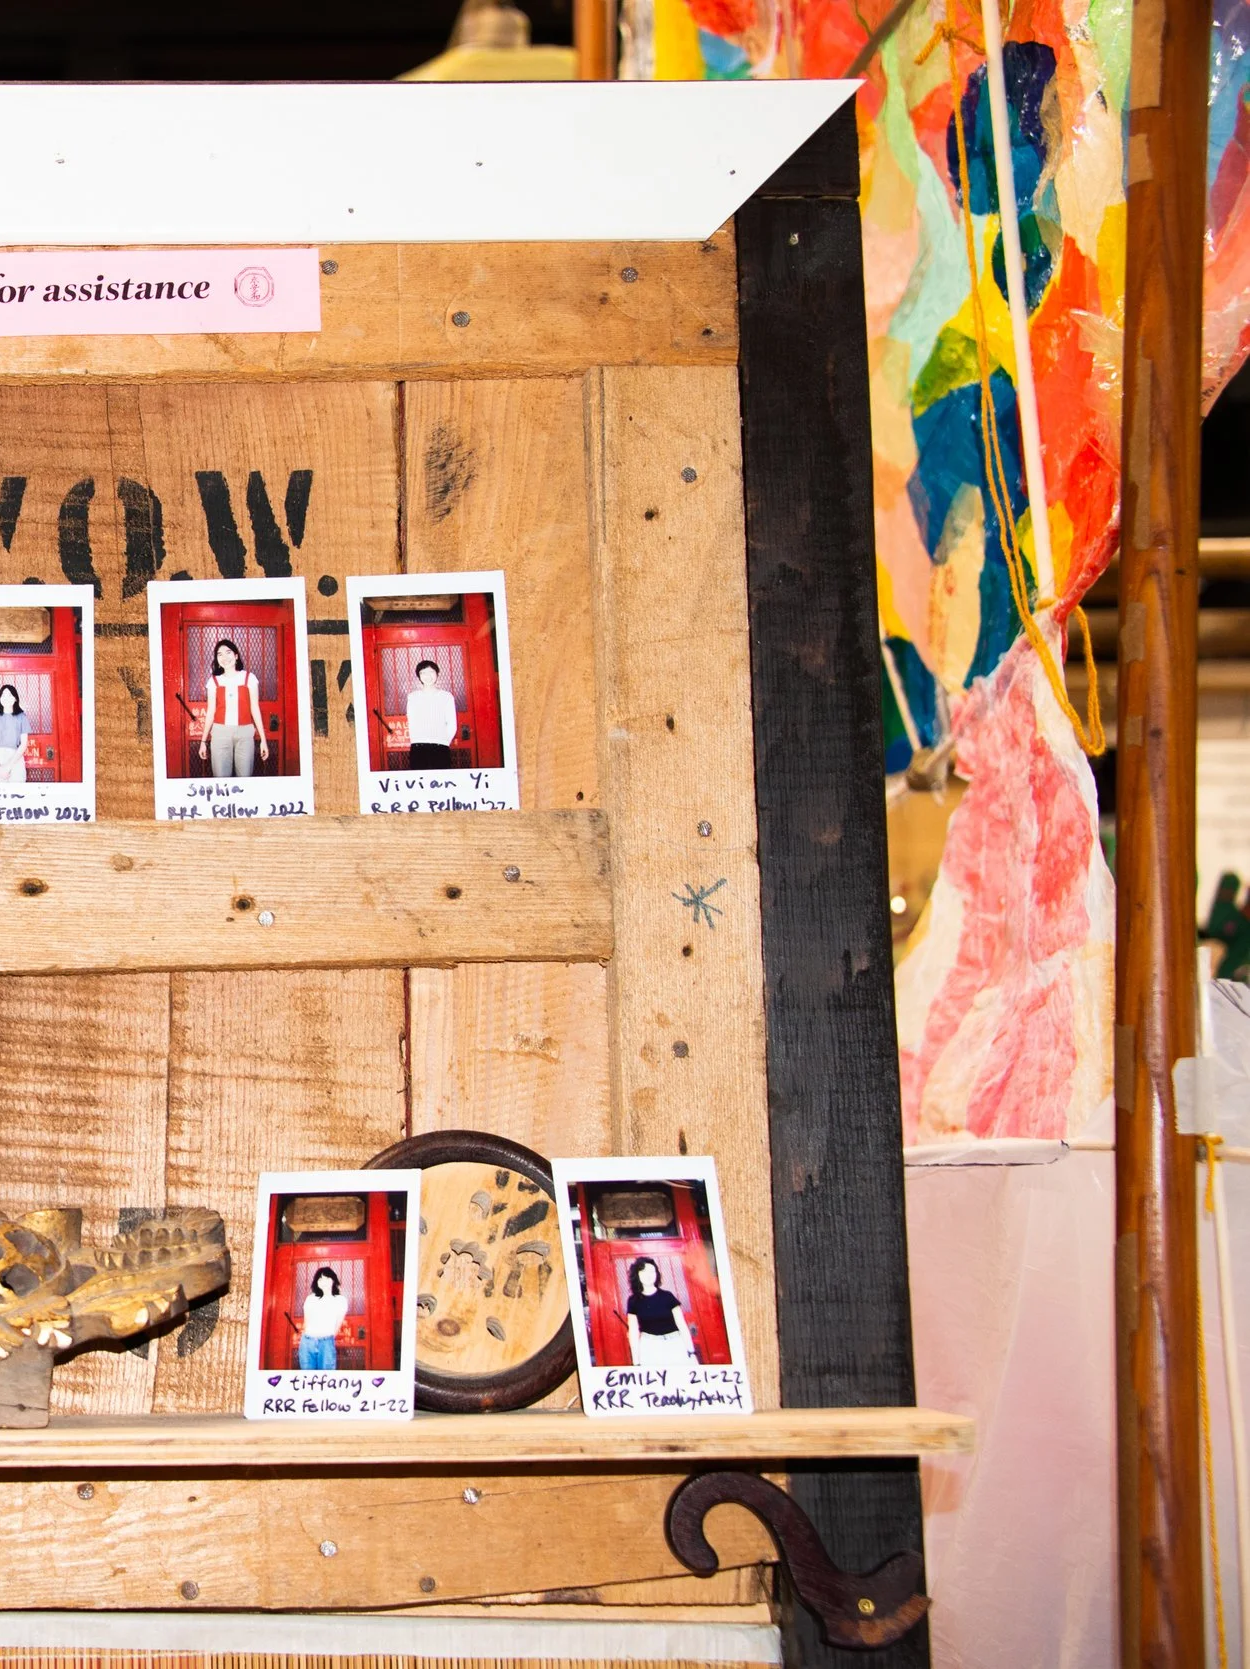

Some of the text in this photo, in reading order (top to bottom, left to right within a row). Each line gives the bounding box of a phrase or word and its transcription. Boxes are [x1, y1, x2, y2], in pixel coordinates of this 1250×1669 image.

[43, 272, 211, 302] assistance
[187, 783, 244, 801] Sophia
[379, 772, 489, 793] Vivian Yi
[167, 805, 202, 820] RRR
[268, 801, 308, 817] 2022
[371, 801, 420, 814] RRR
[290, 1374, 362, 1398] tiffany
[605, 1369, 743, 1387] EMILY 21-22
[263, 1398, 409, 1415] RRR Fellow 21-22
[592, 1389, 634, 1411] RRR
